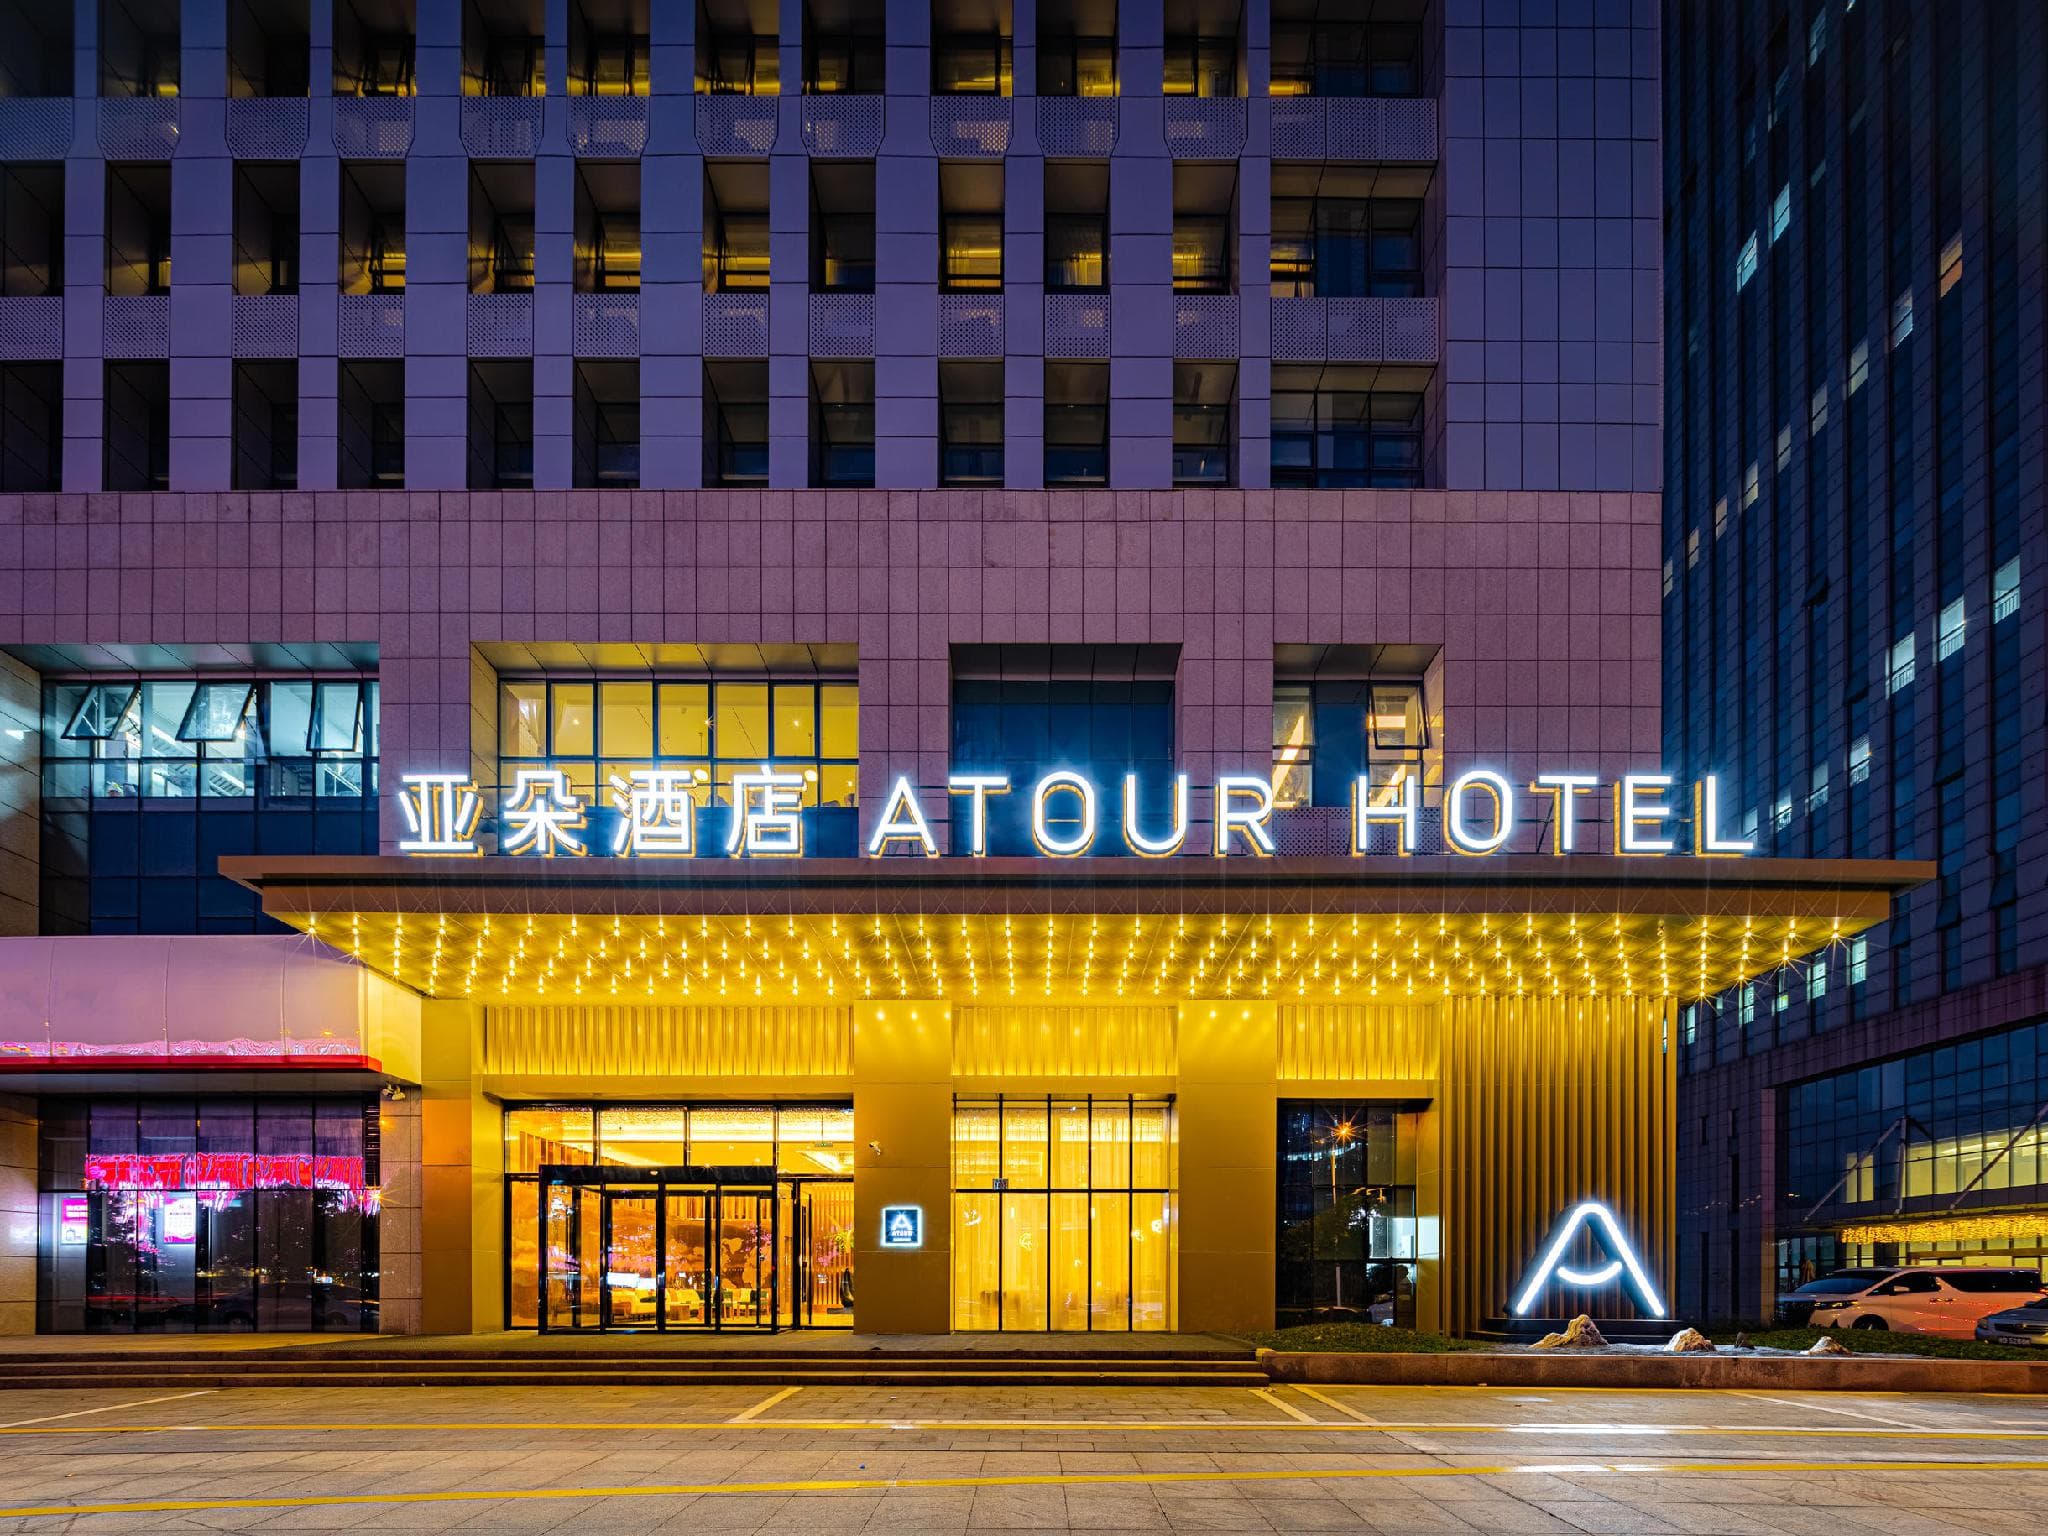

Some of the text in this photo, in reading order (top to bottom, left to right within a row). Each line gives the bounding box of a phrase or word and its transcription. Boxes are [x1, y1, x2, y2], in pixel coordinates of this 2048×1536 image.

[398, 765, 804, 854] 亚朵酒店
[869, 770, 1754, 853] ATOUR HOTEL
[1515, 1202, 1666, 1317] A
